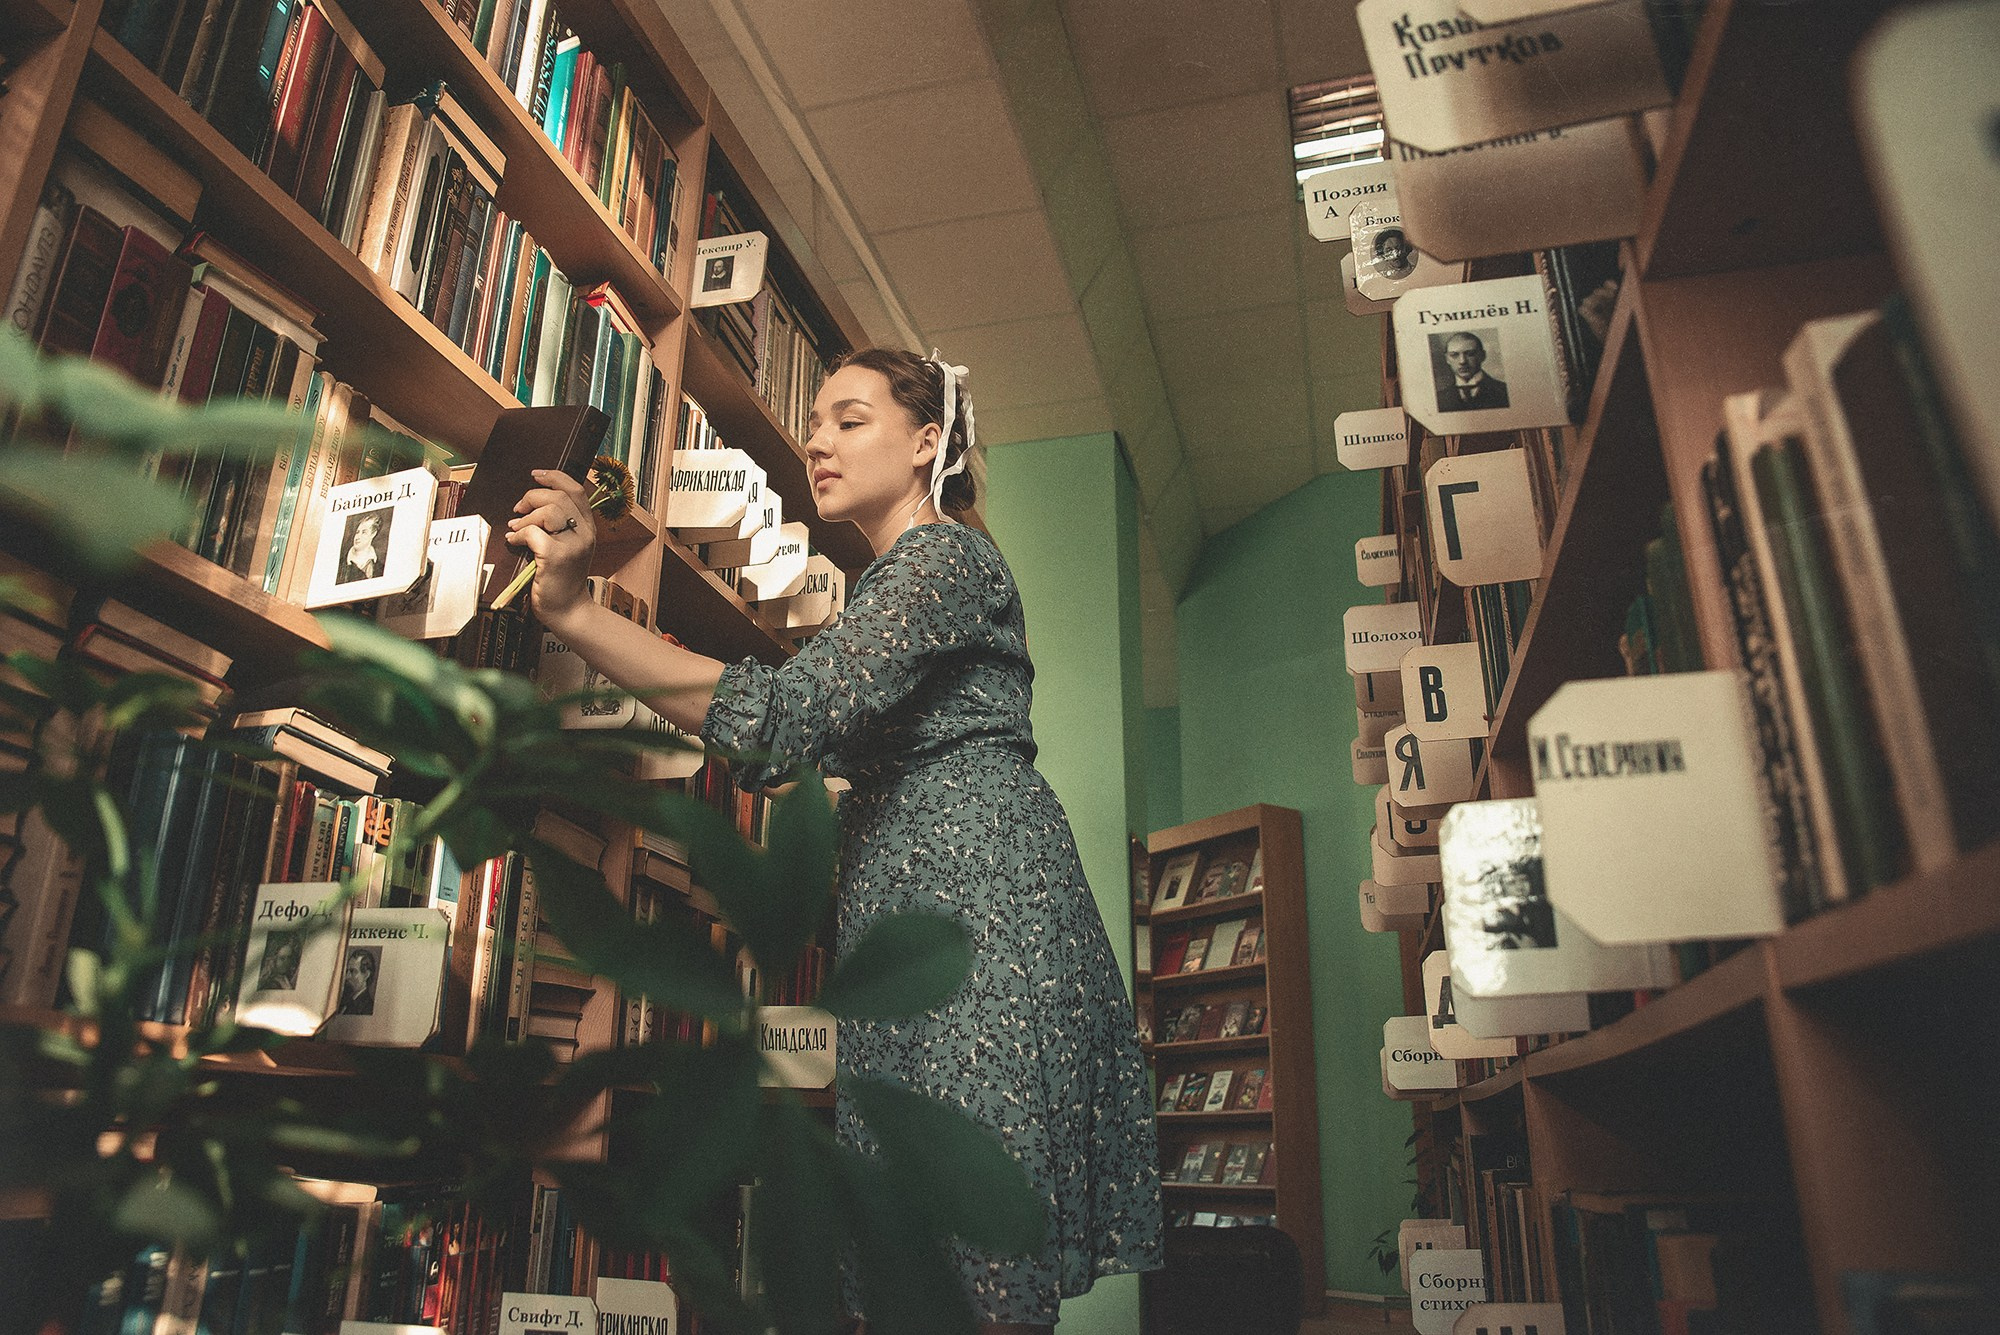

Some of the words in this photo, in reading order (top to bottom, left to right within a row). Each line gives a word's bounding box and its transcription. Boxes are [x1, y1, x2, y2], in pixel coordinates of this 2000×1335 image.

[1393, 13, 1477, 50] Козь
[533, 33, 557, 121] ULYSSES
[1313, 182, 1387, 203] Поэзия
[1324, 206, 1339, 219] А
[1366, 216, 1400, 226] Блок
[697, 243, 743, 255] експир
[746, 239, 756, 248] У.
[1418, 304, 1509, 326] Гумилёв
[1515, 300, 1538, 315] Н.
[1344, 433, 1405, 446] Шишко
[332, 489, 394, 513] Байрон
[397, 482, 416, 501] Д.
[1438, 481, 1479, 560] Г
[448, 528, 470, 545] Ш.
[801, 573, 828, 594] СКАЯ
[1419, 666, 1448, 722] В
[1395, 734, 1426, 791] Я
[258, 900, 309, 921] Дефо
[310, 899, 332, 920] Д.
[349, 927, 408, 939] иккенс
[412, 923, 429, 939] Ч.
[1392, 1049, 1443, 1064] Сборн
[508, 1306, 562, 1328] Свифт
[565, 1310, 583, 1328] Д.
[601, 1312, 668, 1335] ЕРИКАНСКАЯ
